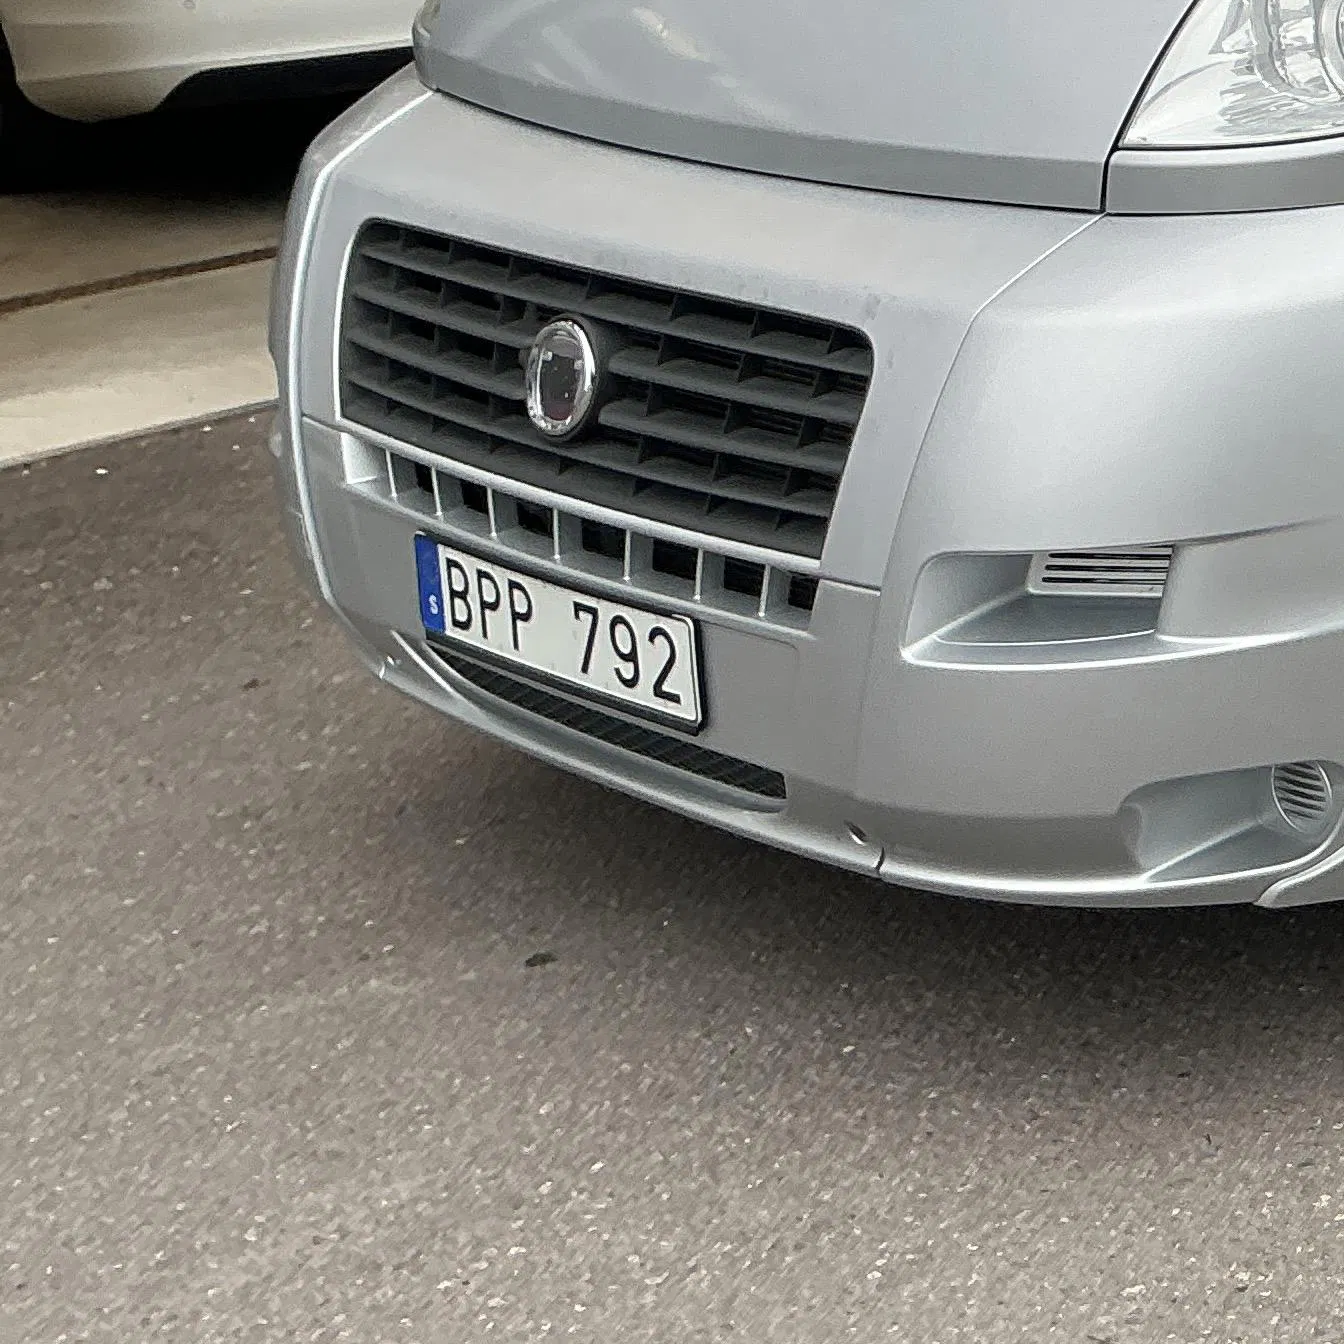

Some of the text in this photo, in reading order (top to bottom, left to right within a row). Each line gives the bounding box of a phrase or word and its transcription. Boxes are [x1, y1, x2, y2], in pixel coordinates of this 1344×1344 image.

[428, 594, 439, 616] S
[445, 556, 683, 706] BPP 792
